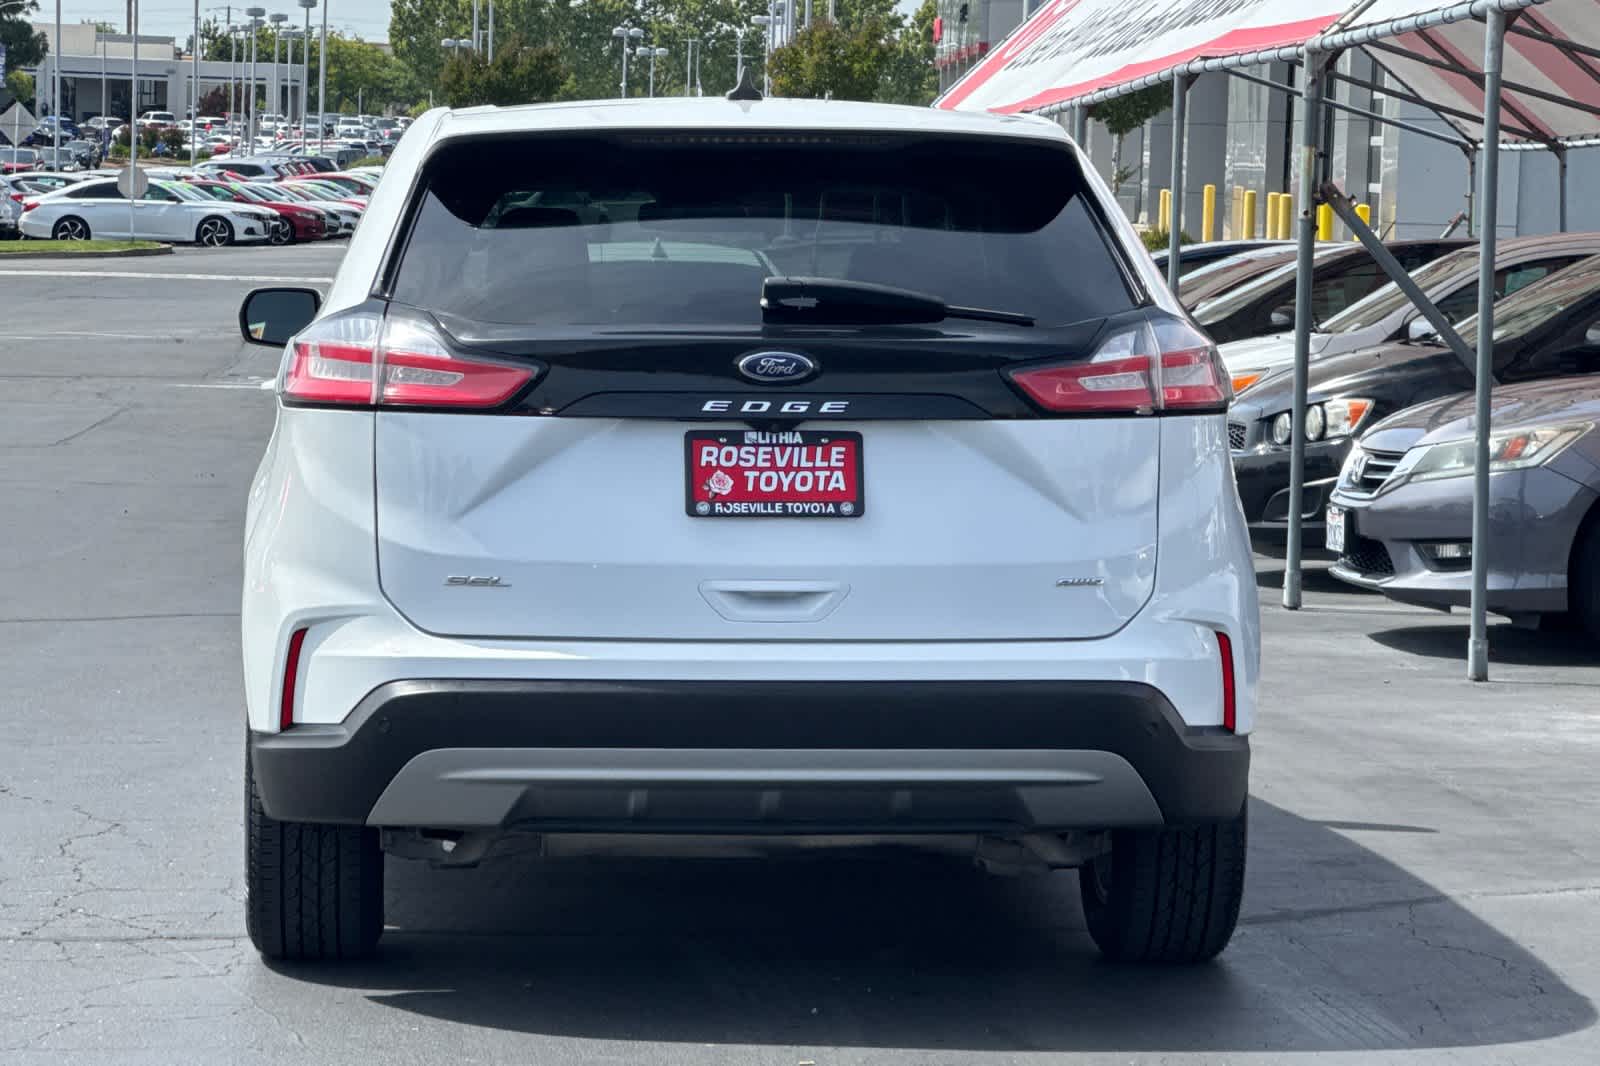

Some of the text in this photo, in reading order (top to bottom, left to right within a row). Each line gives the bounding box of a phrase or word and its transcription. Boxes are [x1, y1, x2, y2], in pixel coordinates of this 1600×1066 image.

[756, 357, 796, 375] Ford
[702, 400, 849, 413] EDGE
[757, 432, 803, 444] LITHIA
[700, 446, 846, 468] ROSEVILLE
[744, 470, 847, 492] TOYOTA
[715, 502, 836, 514] ROSEVILLE TOYOTA
